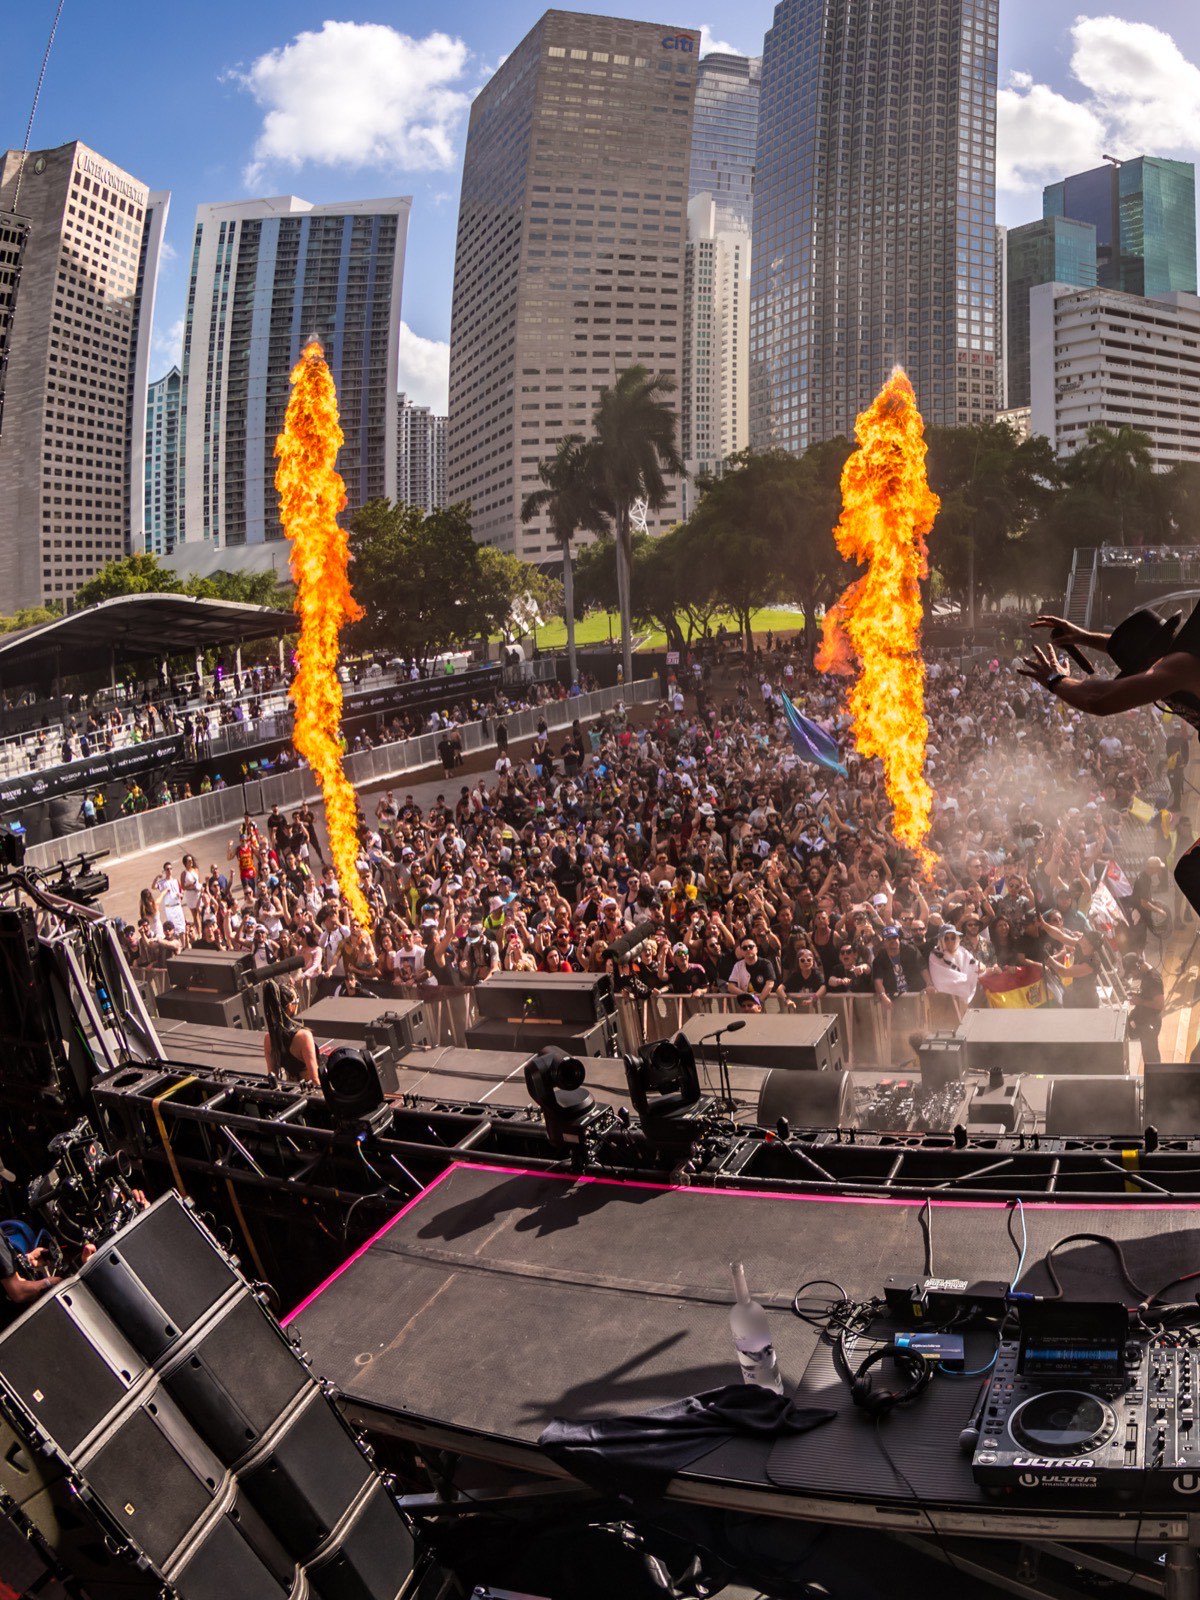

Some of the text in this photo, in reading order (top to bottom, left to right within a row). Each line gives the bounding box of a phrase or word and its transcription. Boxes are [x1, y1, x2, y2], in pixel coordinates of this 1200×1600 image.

[661, 34, 694, 53] citi
[1012, 1457, 1095, 1469] ULTRA
[1041, 1475, 1098, 1484] ULTRA
